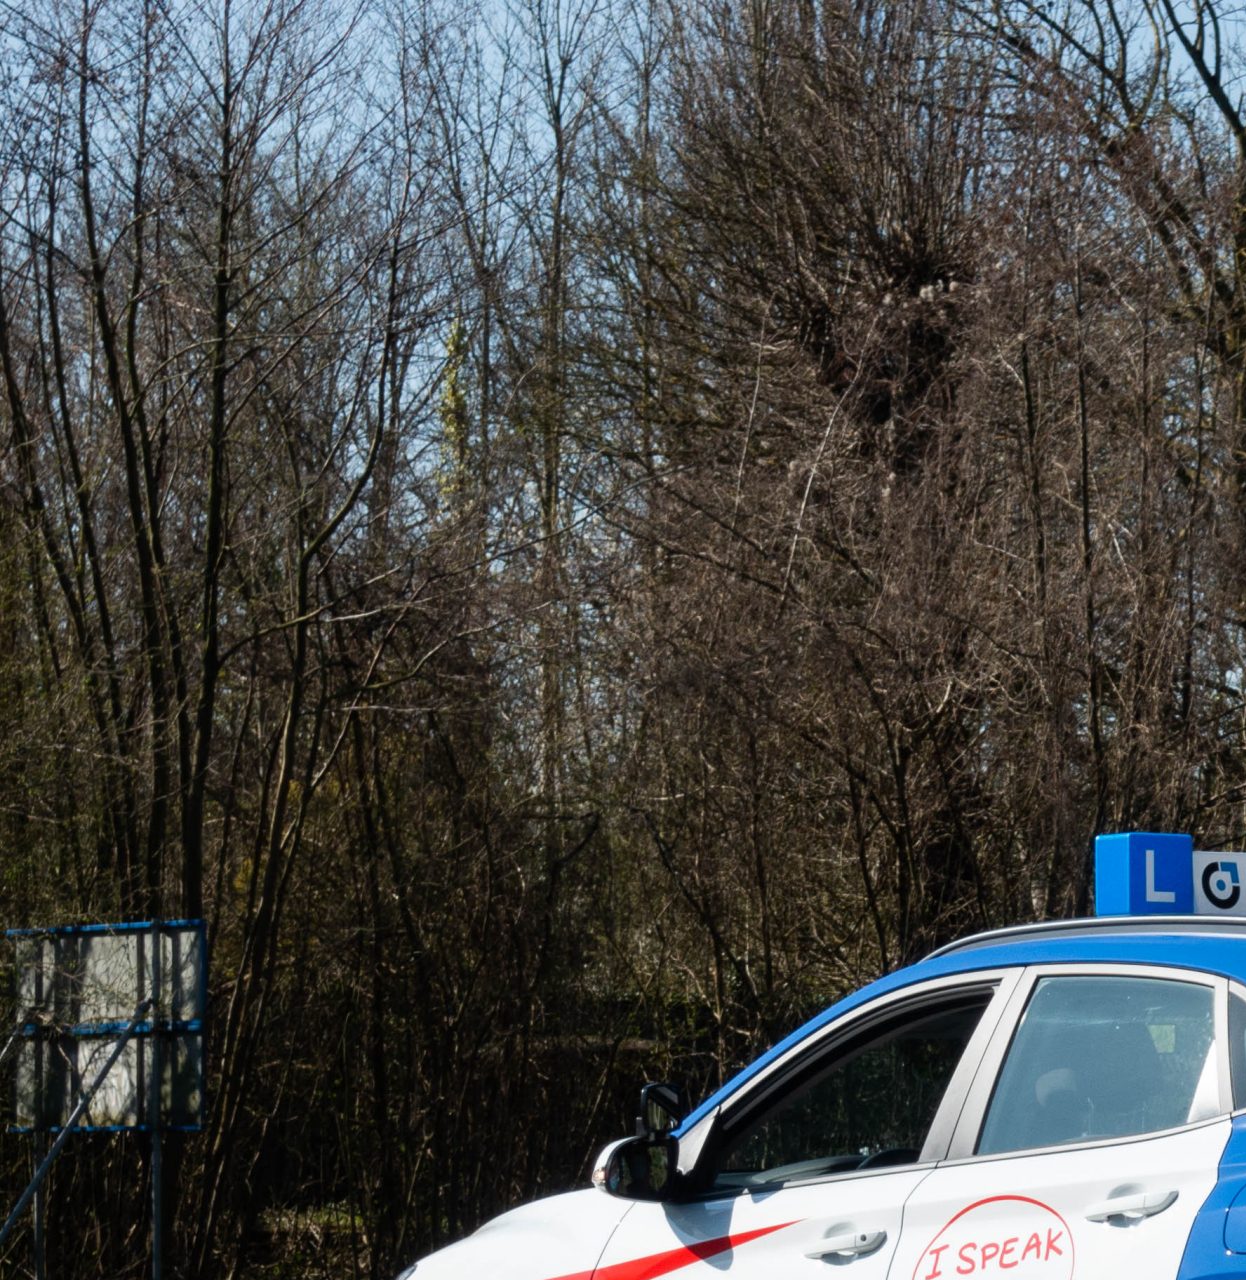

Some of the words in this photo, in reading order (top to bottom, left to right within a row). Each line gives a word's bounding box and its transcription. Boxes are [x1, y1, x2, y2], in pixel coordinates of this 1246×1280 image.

[1144, 849, 1176, 903] L
[925, 1244, 950, 1280] I
[956, 1227, 1063, 1275] SPEAK
